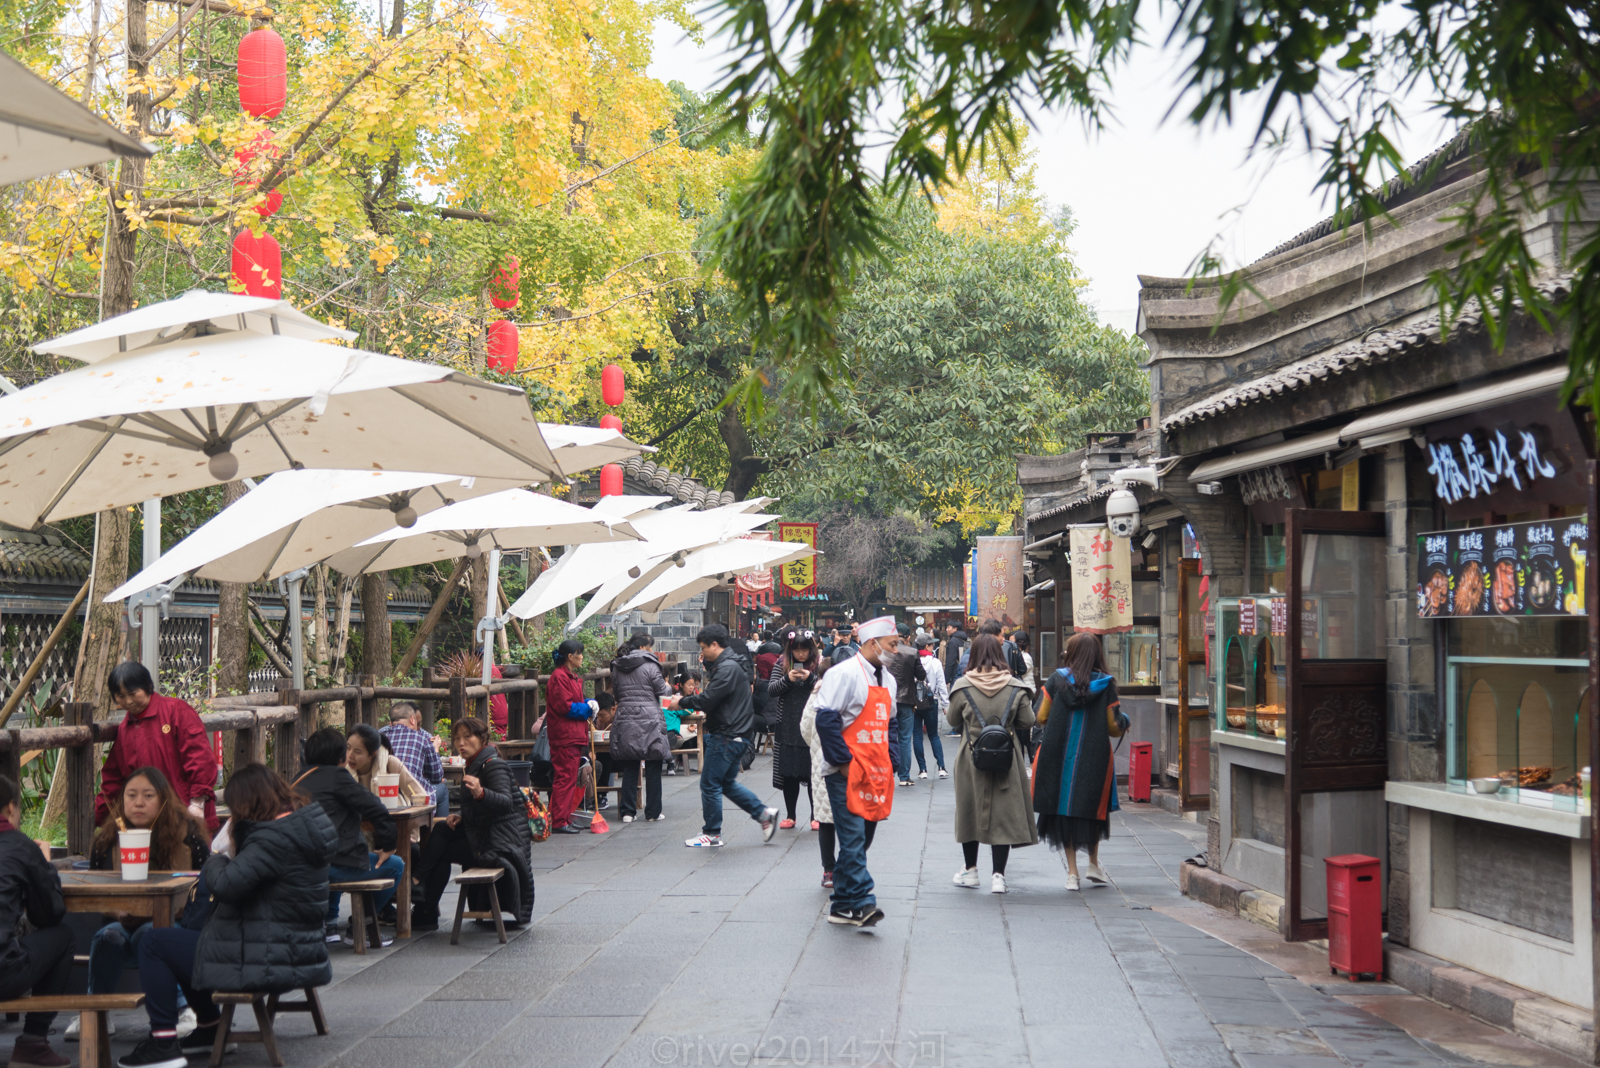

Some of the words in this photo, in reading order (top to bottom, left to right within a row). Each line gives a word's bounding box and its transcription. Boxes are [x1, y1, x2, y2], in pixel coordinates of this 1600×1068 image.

[990, 554, 1010, 611] 黄醪糟
[1076, 546, 1090, 578] 豆腐花
[1091, 534, 1117, 604] 和一味
